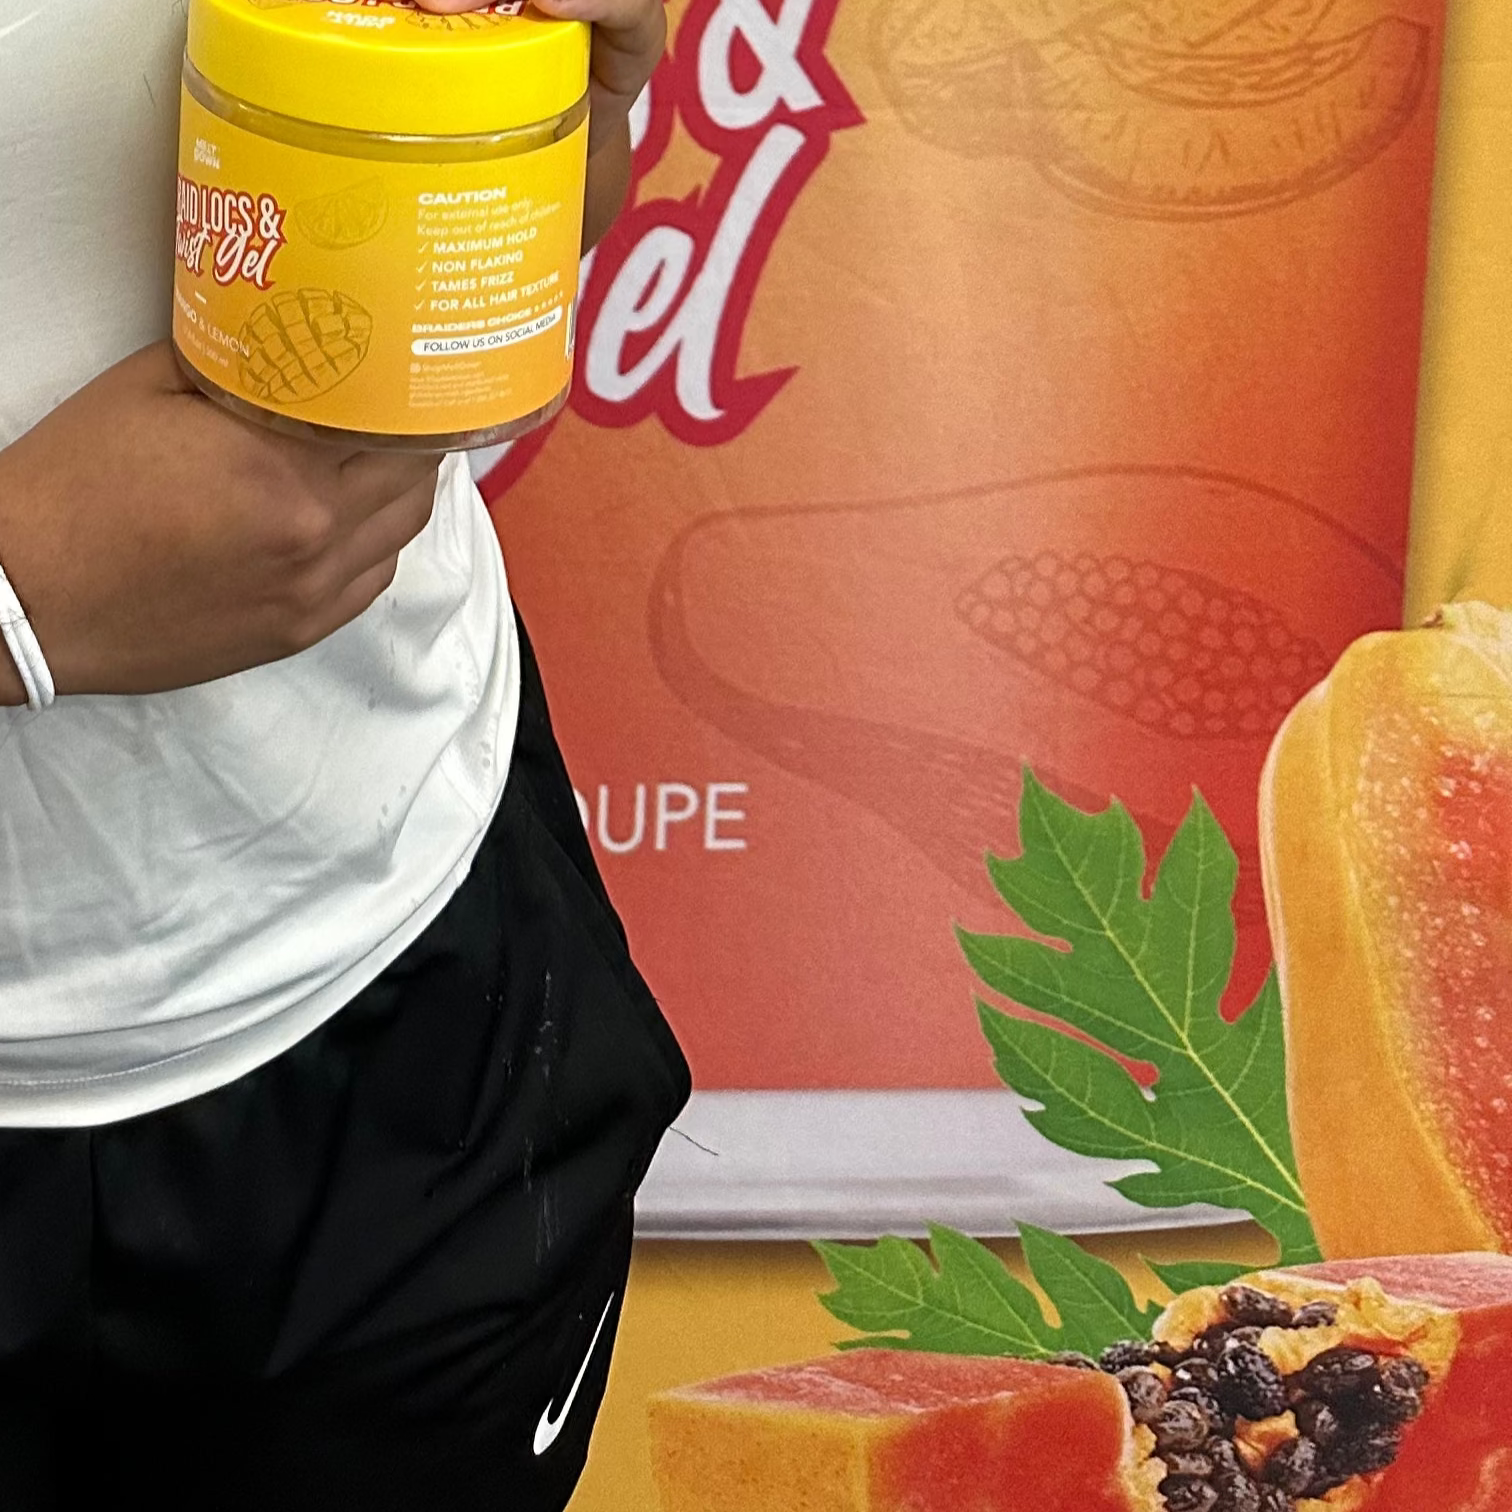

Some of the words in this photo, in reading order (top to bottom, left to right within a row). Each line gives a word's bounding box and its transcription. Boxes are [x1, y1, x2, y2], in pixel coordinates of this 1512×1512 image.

[417, 186, 508, 206] CAUTION
[201, 188, 253, 238] LOCS
[259, 197, 281, 240] &
[417, 223, 449, 238] Keep
[433, 236, 504, 255] MAXIMUM
[506, 226, 538, 246] HOLD
[431, 260, 467, 274] NON
[469, 250, 524, 269] FLAKING
[579, 123, 808, 422] el
[430, 298, 460, 313] FOR
[462, 295, 487, 309] ALL
[489, 288, 519, 307] HAIR
[521, 270, 561, 298] TEXTURE
[431, 277, 478, 293] TAMES
[480, 270, 515, 288] FRIZZ
[411, 318, 486, 334] BRAIDERS
[486, 306, 533, 328] CHOICE
[423, 341, 471, 353] FOLLOW
[472, 338, 486, 349] US
[487, 333, 504, 346] ON
[504, 325, 535, 343] SOCIAL
[534, 312, 557, 331] MEDIA
[207, 323, 251, 359] LEMON
